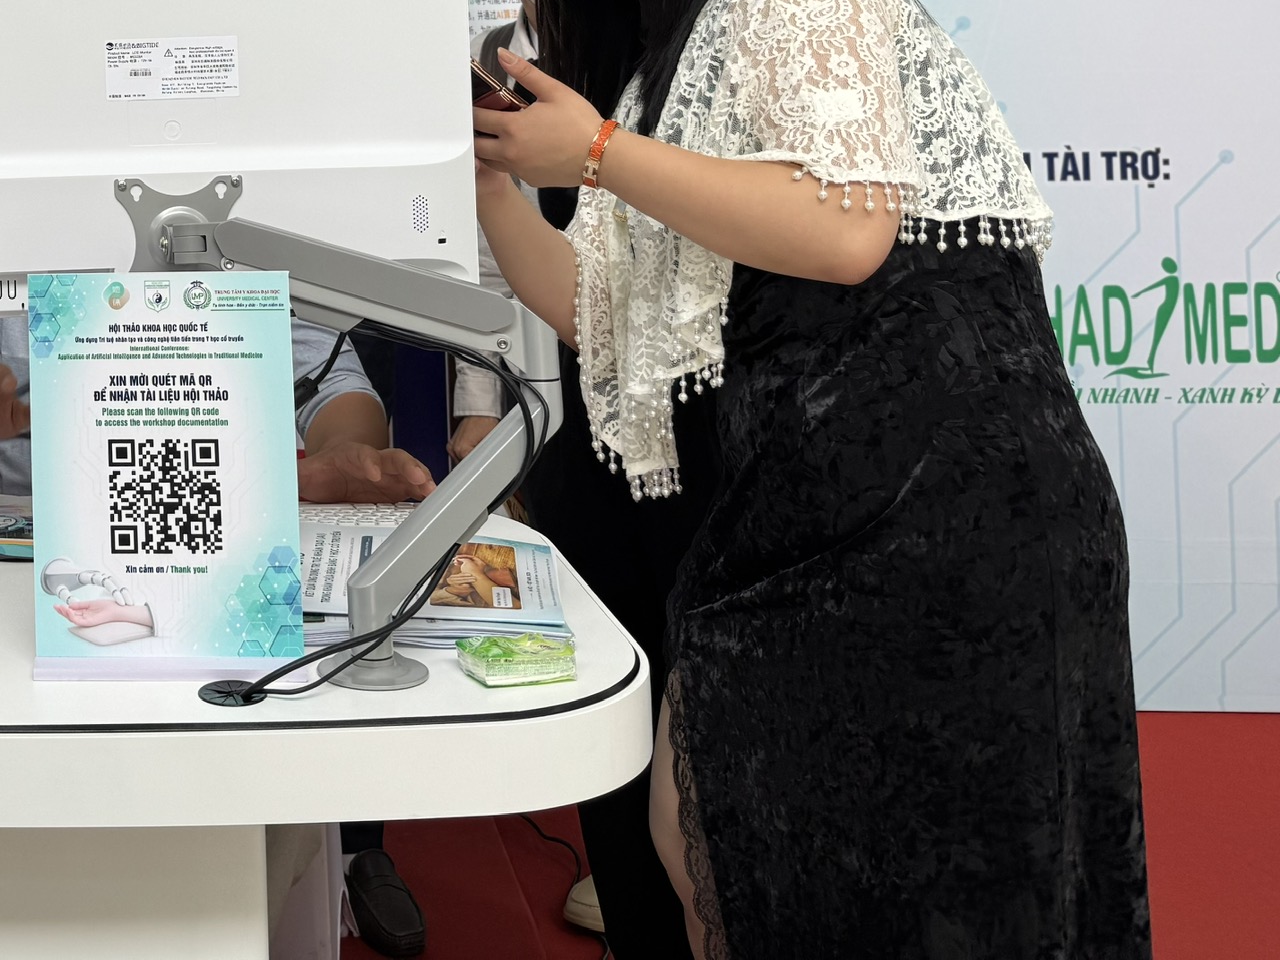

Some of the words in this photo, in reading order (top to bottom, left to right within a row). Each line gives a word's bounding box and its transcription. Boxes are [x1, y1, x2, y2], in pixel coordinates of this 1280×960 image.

[1042, 145, 1091, 182] TÀI
[1100, 147, 1171, 188] TRỢ:
[109, 323, 120, 334] HỘI
[123, 322, 140, 332] THẢO
[142, 324, 161, 332] KHOA
[163, 324, 177, 333] HỌC
[179, 321, 198, 332] QUỐC
[200, 321, 208, 332] TẾ
[109, 375, 127, 386] XIN
[130, 373, 149, 386] MỜI
[152, 373, 176, 386] QUÉT
[179, 373, 196, 386] MÃ
[199, 375, 212, 386] QR
[94, 386, 107, 401] ĐỂ
[110, 388, 137, 403] NHẬN
[140, 388, 156, 401] TÀI
[159, 388, 180, 403] LIỆU
[183, 388, 200, 403] HỘI
[203, 386, 228, 401] THẢO
[1087, 388, 1160, 404] NHANH
[1178, 388, 1236, 404] XANH
[157, 408, 189, 416] following
[191, 408, 200, 416] QR
[142, 419, 175, 427] workshop
[126, 565, 137, 573] Xin
[139, 564, 154, 573] cảm
[170, 565, 191, 573] Thank
[193, 565, 208, 574] you!
